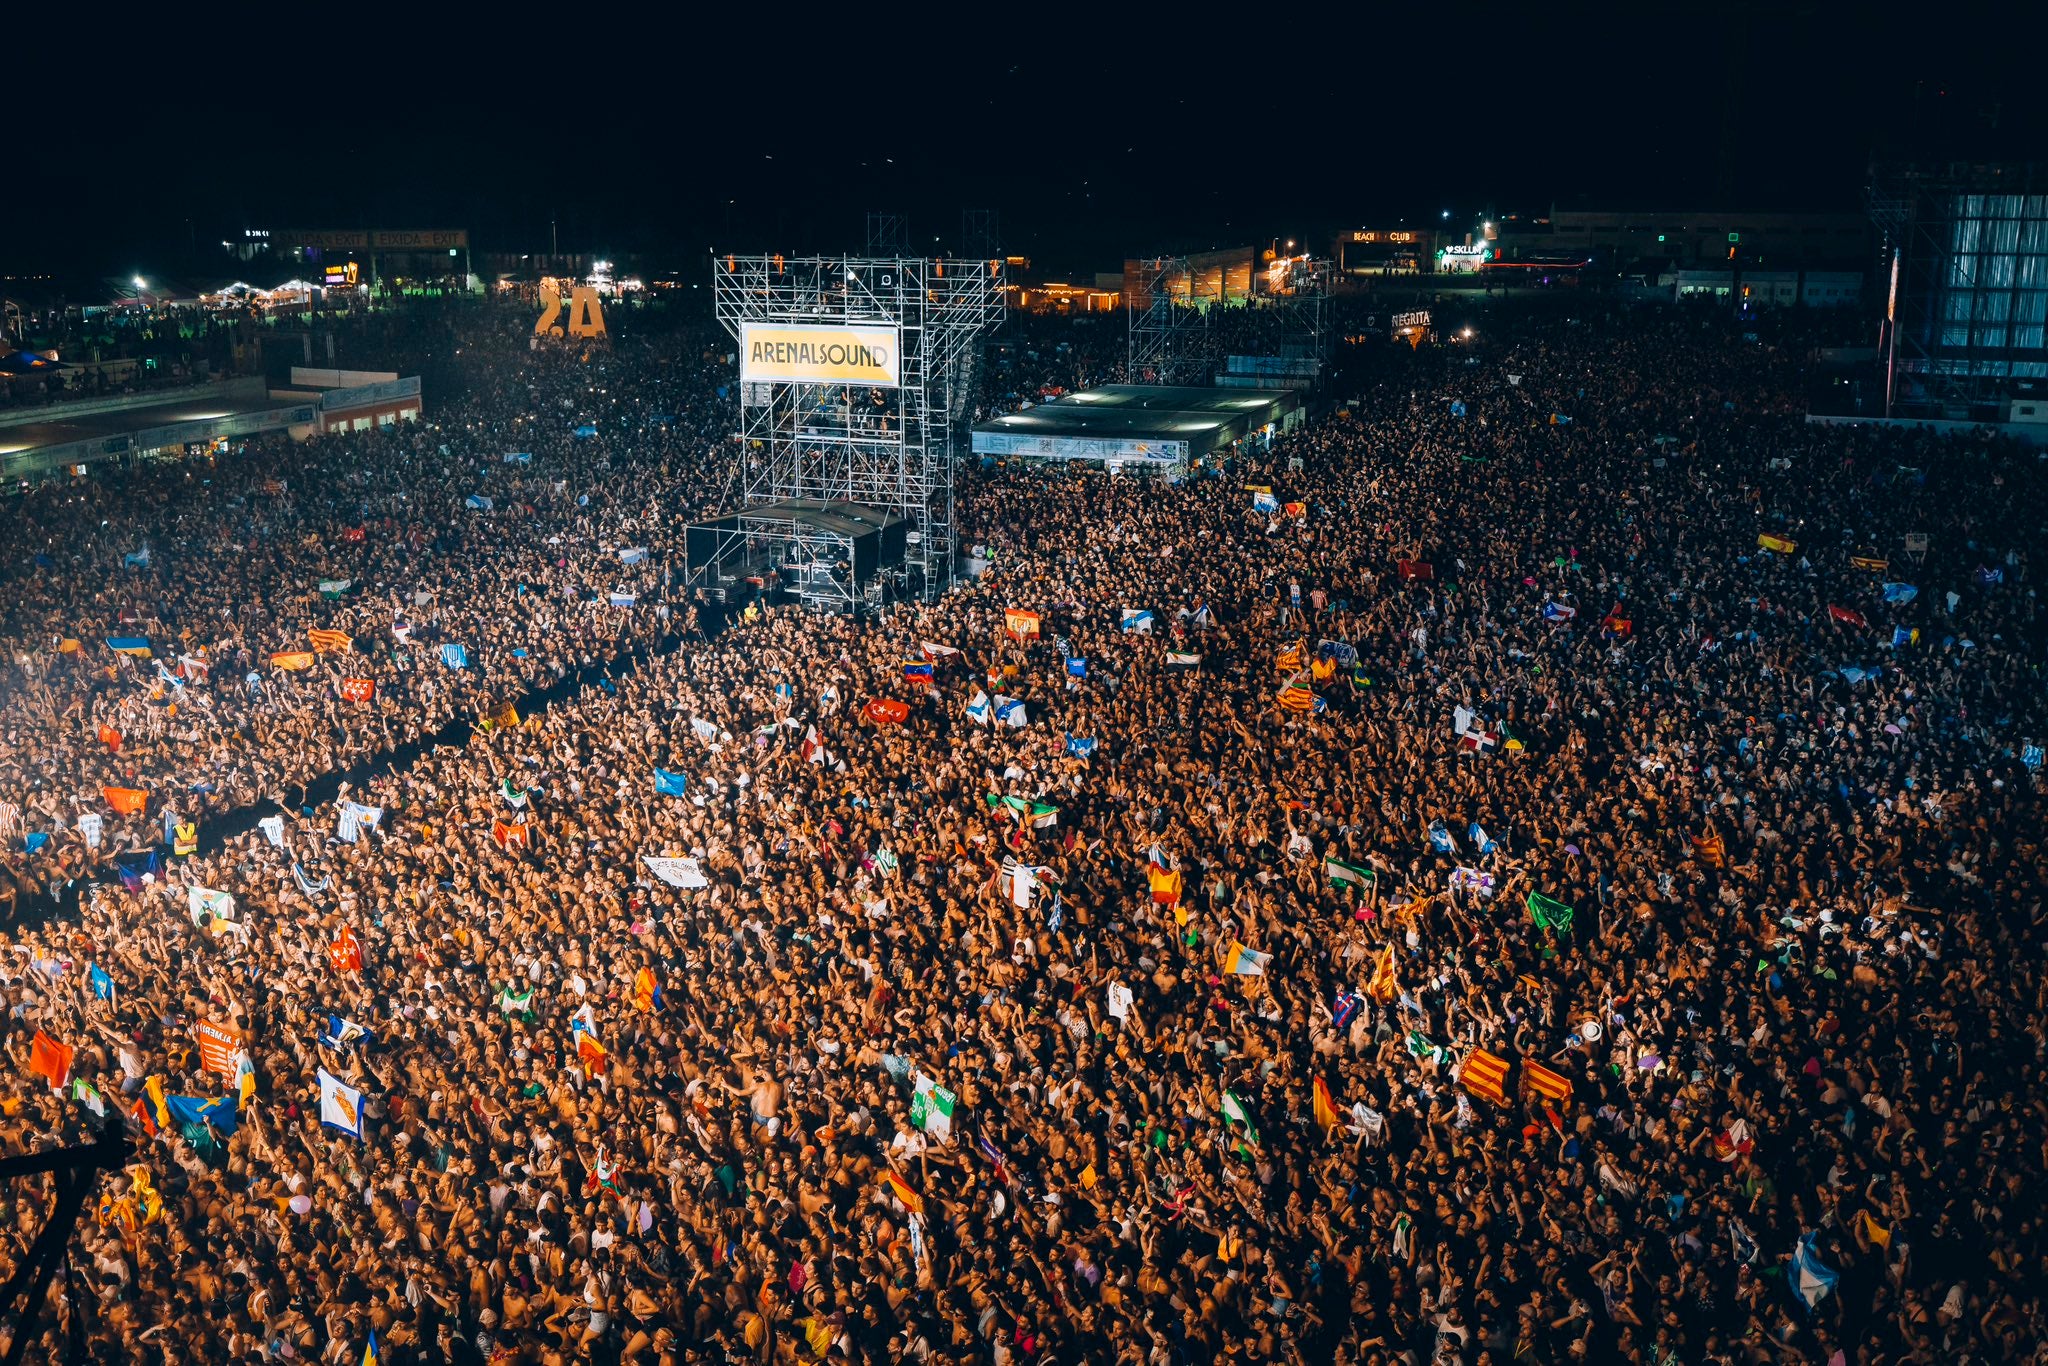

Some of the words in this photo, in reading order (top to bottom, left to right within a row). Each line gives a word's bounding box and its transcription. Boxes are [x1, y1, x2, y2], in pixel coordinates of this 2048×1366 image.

[335, 233, 362, 246] EXIT
[380, 233, 421, 246] EIXIDA
[433, 233, 459, 246] EXIT
[1353, 232, 1375, 241] BEACH
[1390, 232, 1410, 241] CLUB
[1454, 245, 1482, 255] SKLUM
[1391, 310, 1430, 328] NEGRITA
[751, 341, 888, 368] ARENALSOUND
